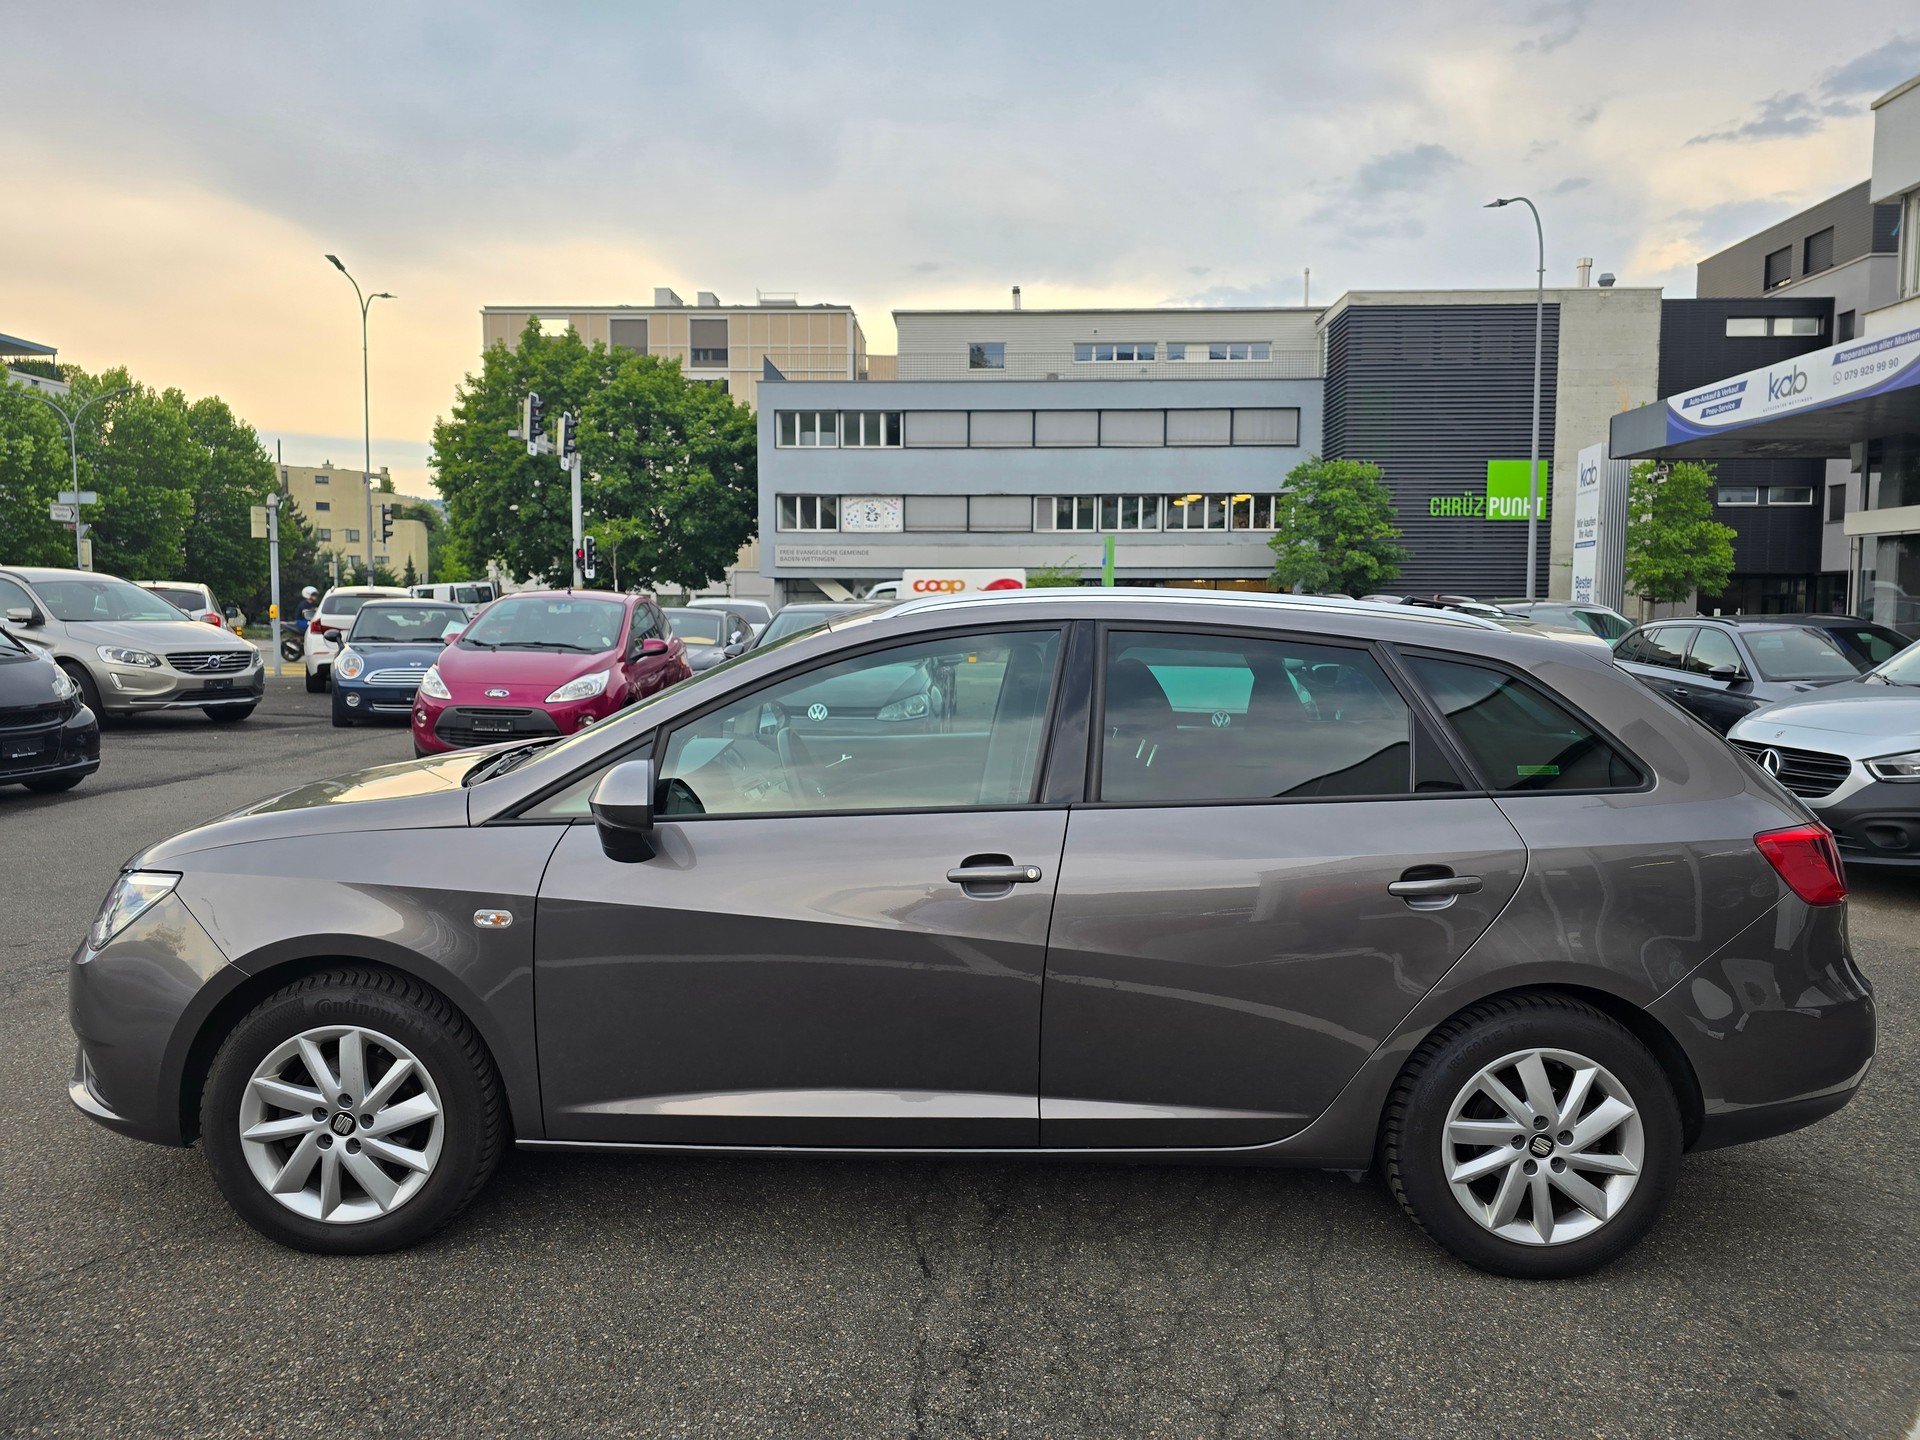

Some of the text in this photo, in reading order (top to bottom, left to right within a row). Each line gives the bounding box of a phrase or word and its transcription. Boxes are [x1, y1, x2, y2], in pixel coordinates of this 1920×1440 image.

[1840, 331, 1920, 361] Reparaturen aller Marken
[1844, 357, 1899, 381] 079 929 99 90
[1689, 391, 1717, 405] Auto-Ankauf
[1721, 384, 1740, 397] Verkauf
[1768, 364, 1808, 402] kab
[1705, 402, 1735, 416] Pneu-Service
[1580, 460, 1598, 488] kab
[1430, 490, 1484, 516] CHRÜZ
[913, 579, 965, 594] coop
[1575, 576, 1592, 589] Bester
[1576, 590, 1590, 603] Preis
[314, 998, 415, 1032] Continental
